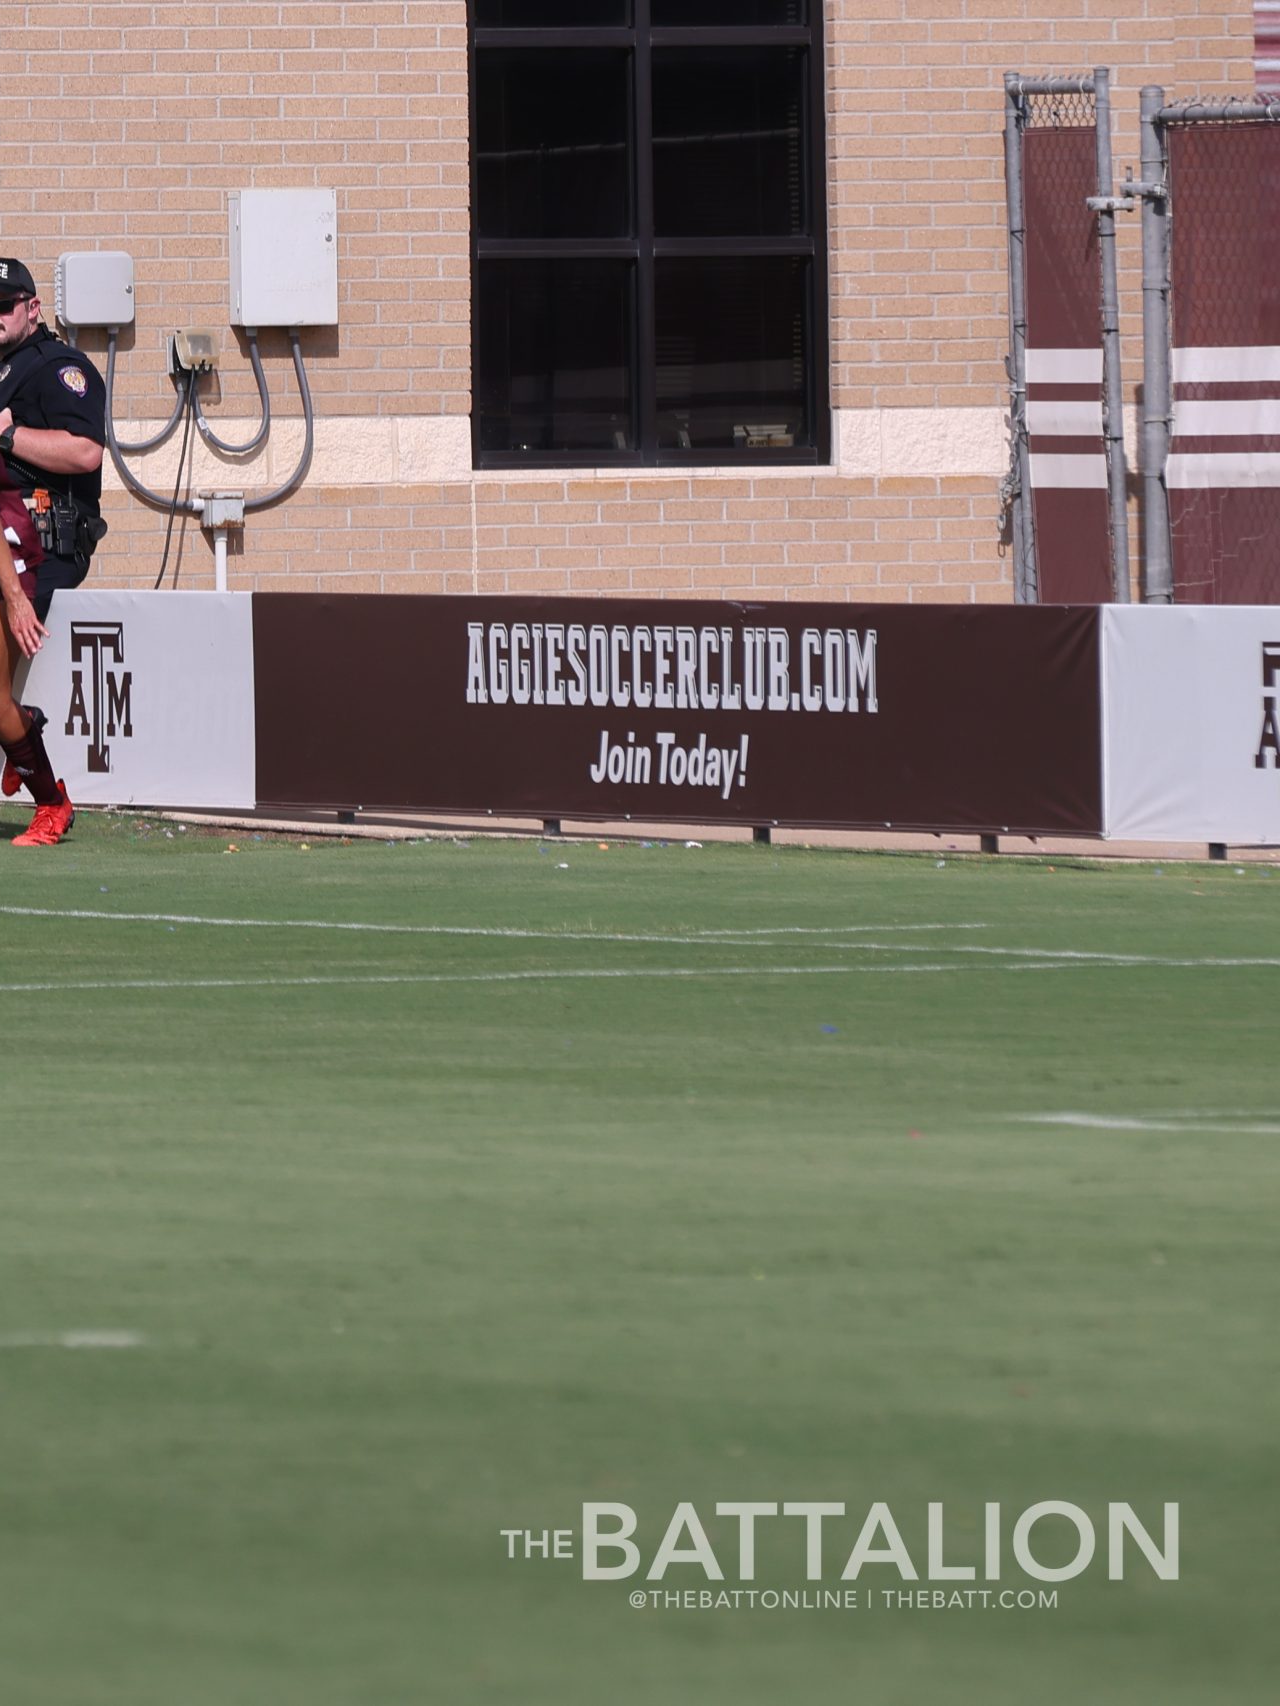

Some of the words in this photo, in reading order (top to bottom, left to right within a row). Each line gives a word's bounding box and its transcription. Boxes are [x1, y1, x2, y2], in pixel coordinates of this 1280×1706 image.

[466, 622, 878, 713] AGGIESOCCERCLUB.COM
[590, 730, 652, 784] Join
[656, 732, 749, 799] Today!
